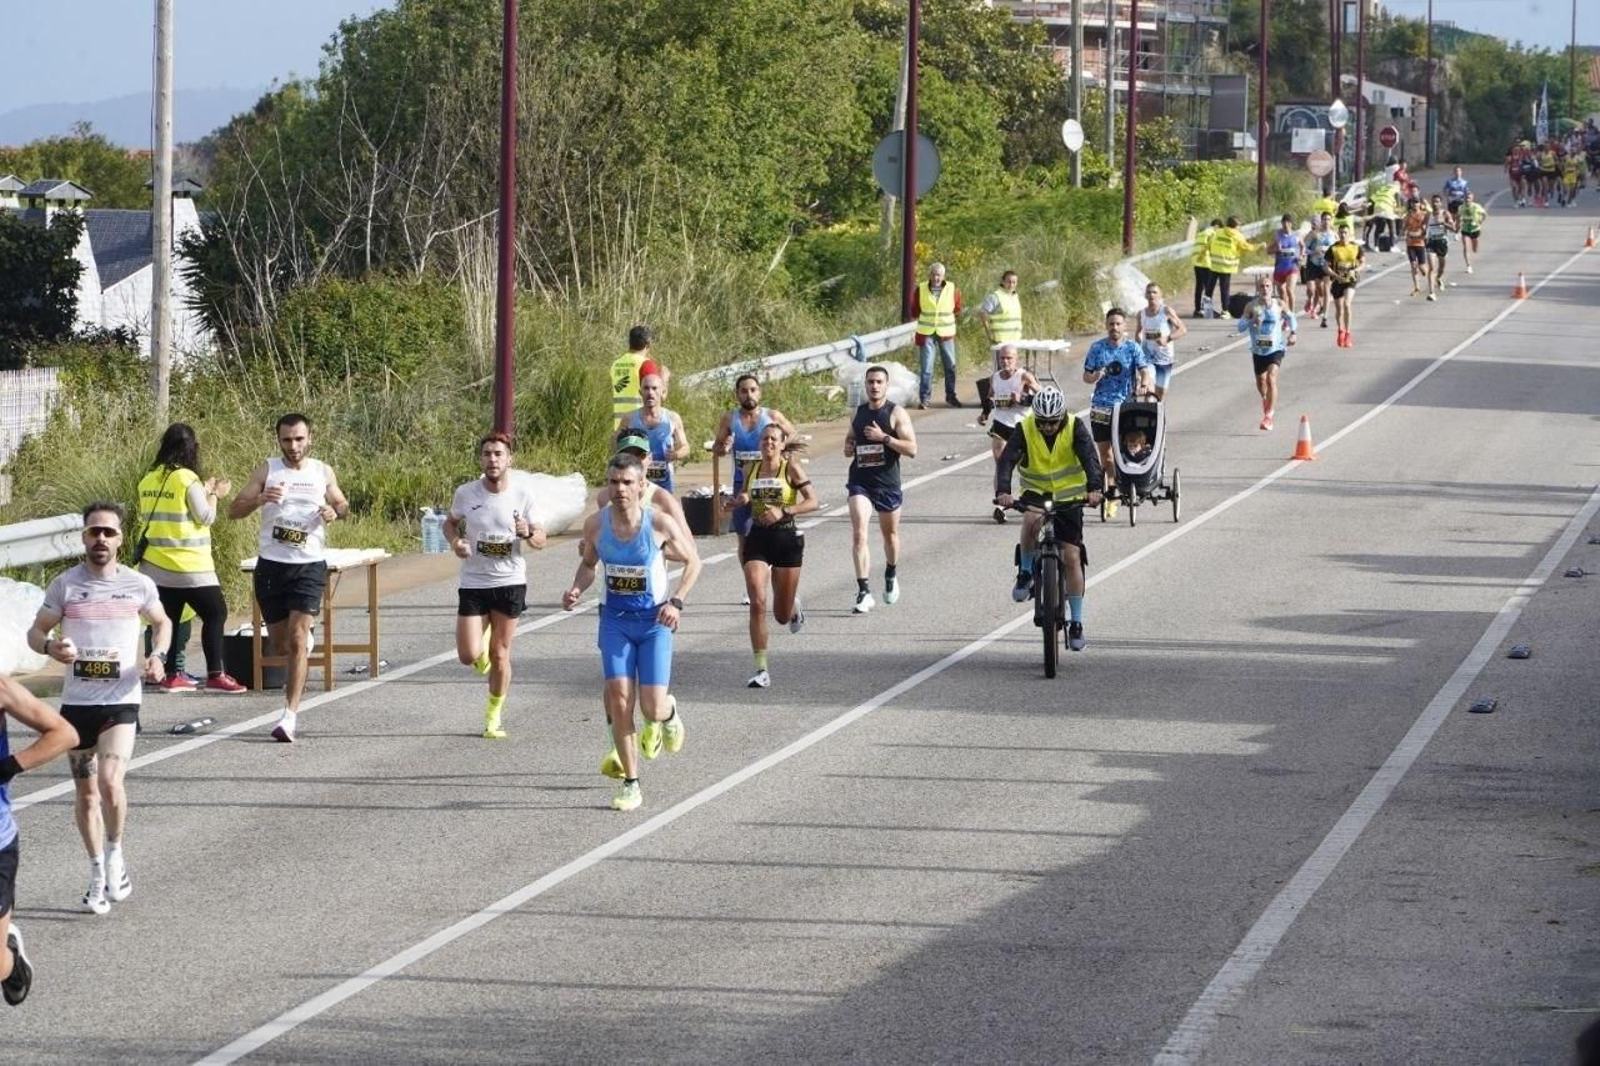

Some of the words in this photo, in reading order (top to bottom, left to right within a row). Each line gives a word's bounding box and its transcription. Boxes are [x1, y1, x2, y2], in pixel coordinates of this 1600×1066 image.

[282, 529, 301, 541] 790
[616, 577, 638, 588] 478
[84, 661, 110, 675] 486
